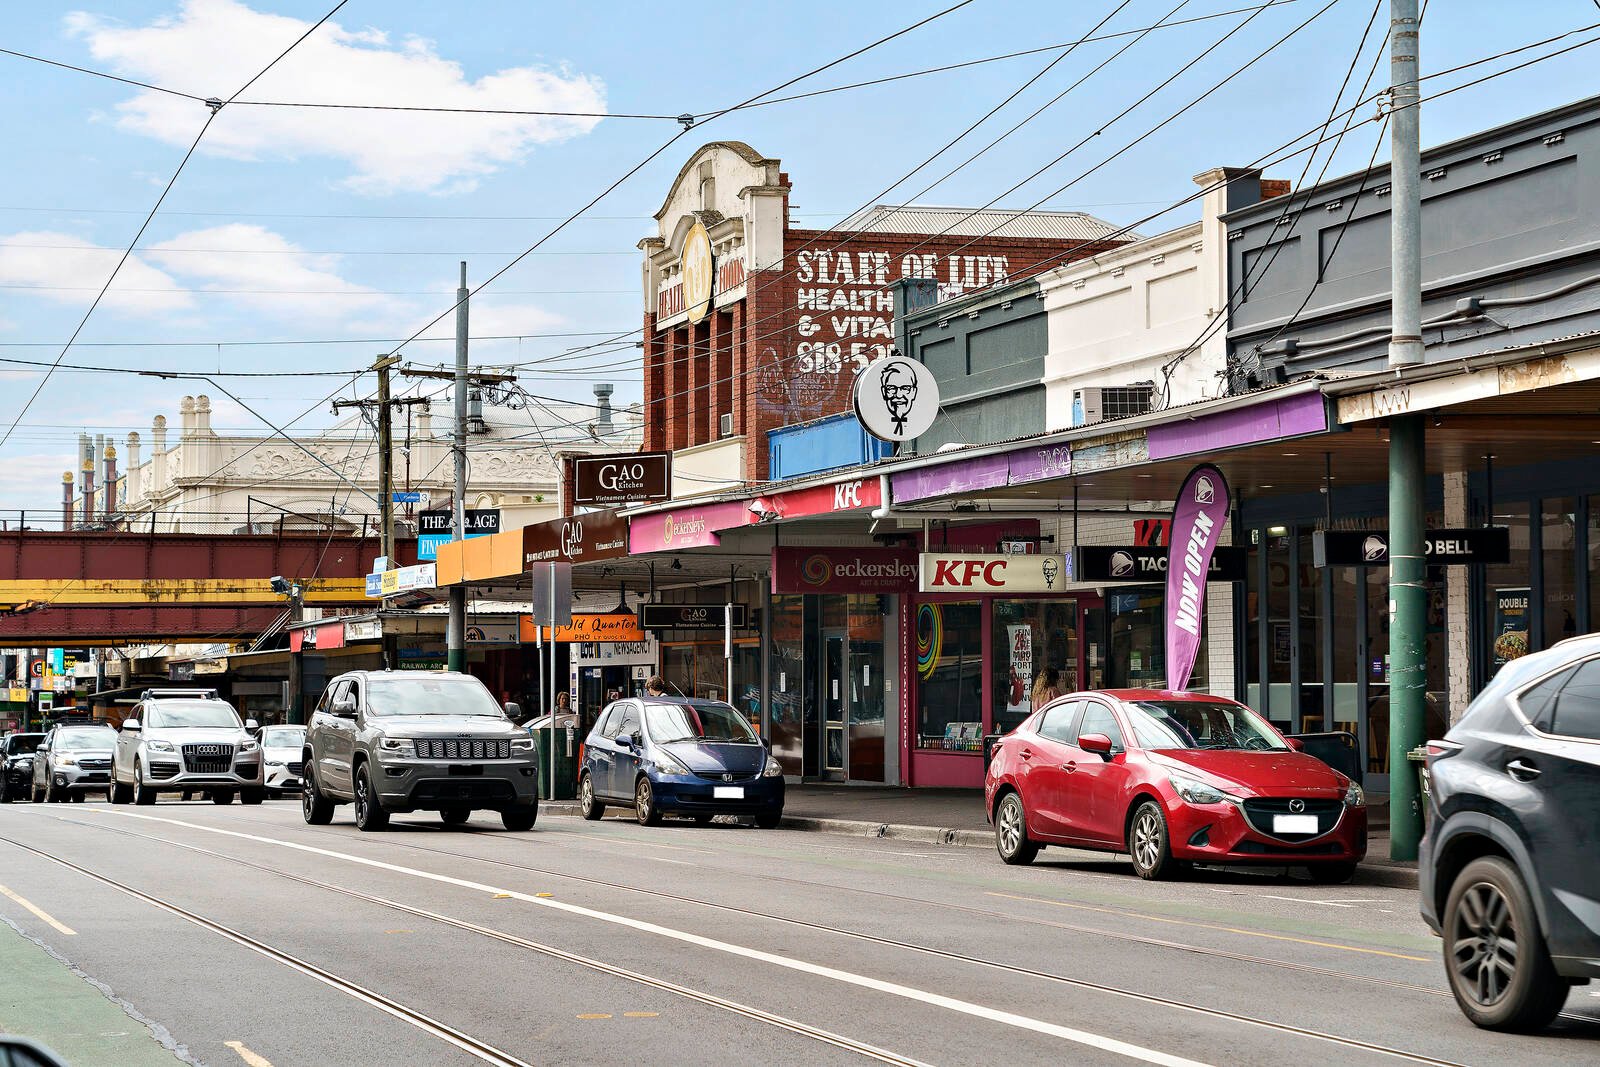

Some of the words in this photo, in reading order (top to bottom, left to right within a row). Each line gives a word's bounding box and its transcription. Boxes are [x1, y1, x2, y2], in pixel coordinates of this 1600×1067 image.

[797, 248, 892, 285] STAFF
[901, 252, 939, 280] OF
[947, 254, 1009, 289] LIFE
[658, 283, 686, 321] HEALT
[719, 257, 749, 294] FOODS
[798, 288, 894, 312] HEALTH
[798, 315, 821, 337] &
[831, 315, 894, 338] VITA
[598, 463, 644, 491] GAO
[618, 481, 643, 489] Kitchen
[596, 494, 625, 502] Vietnamese
[833, 480, 863, 510] KFC
[422, 515, 445, 528] THE
[474, 514, 497, 528] AGE
[561, 520, 583, 560] GAO
[1184, 509, 1215, 577] OPEN
[1435, 539, 1473, 555] BELL
[834, 558, 919, 582] eckersley
[931, 559, 1008, 587] KFC
[1138, 556, 1167, 571] TAC
[1174, 571, 1203, 636] NOW
[1499, 597, 1528, 609] DOUBLE
[592, 617, 636, 632] Quarter
